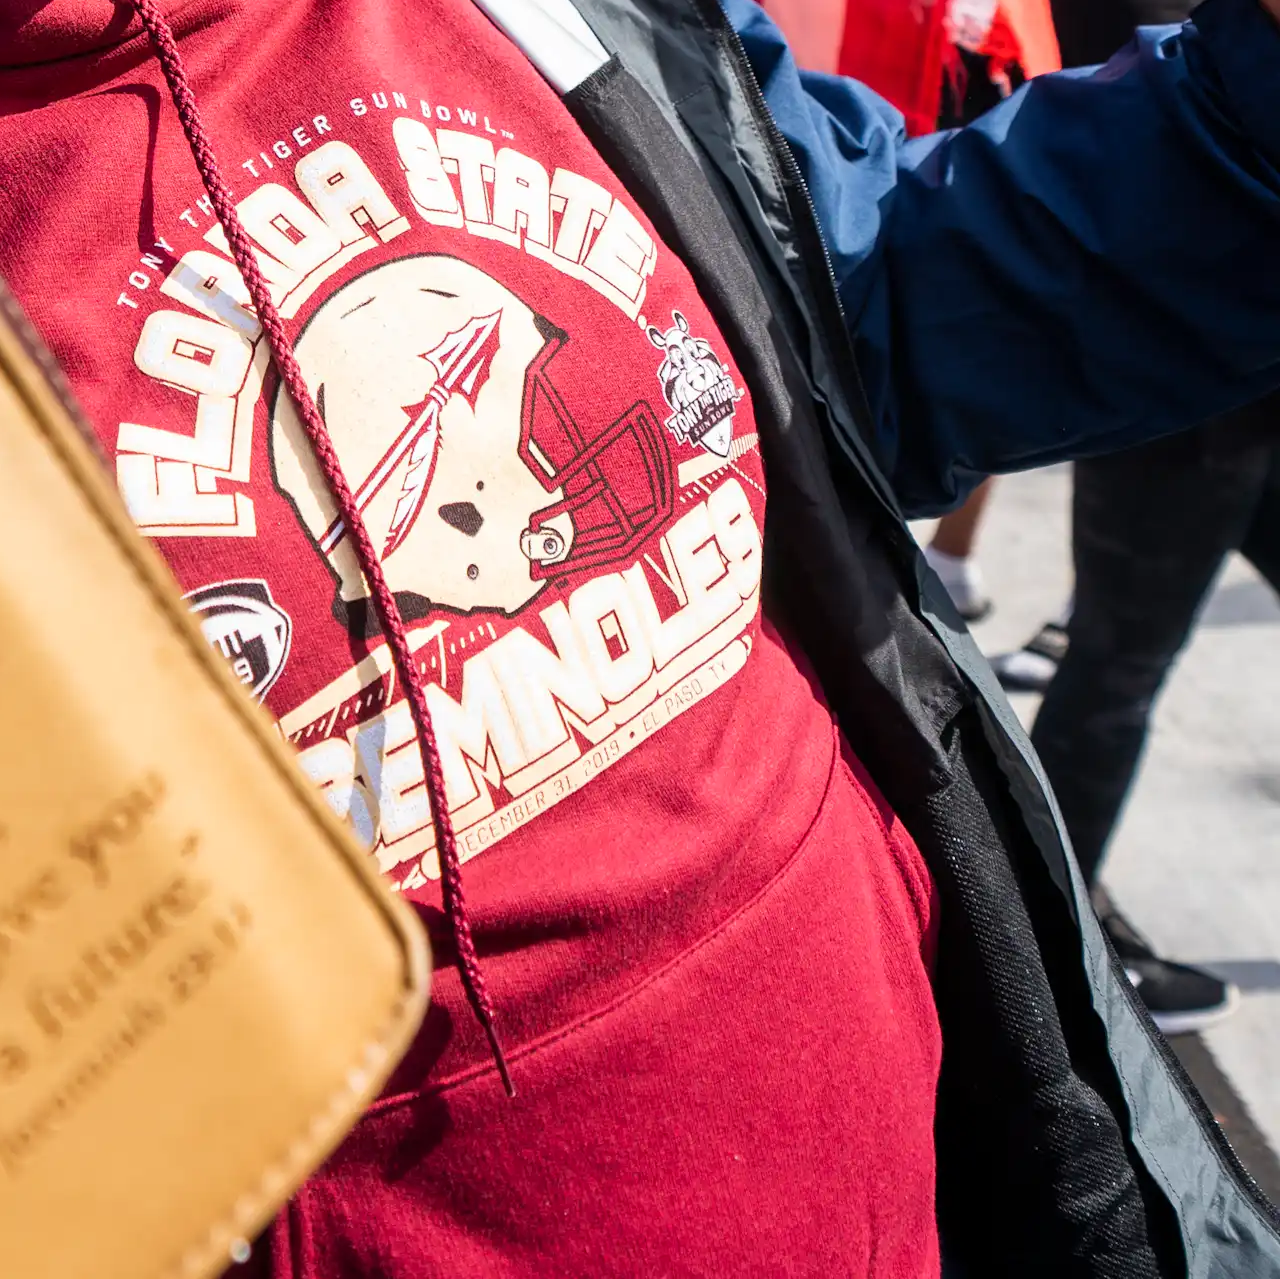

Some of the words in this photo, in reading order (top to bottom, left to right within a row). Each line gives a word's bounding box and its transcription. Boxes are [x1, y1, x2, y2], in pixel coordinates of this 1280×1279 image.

[117, 237, 174, 309] TONY
[179, 183, 234, 228] TH
[242, 114, 333, 178] TIGER
[349, 91, 408, 116] SUN
[393, 116, 658, 322] STATE
[582, 739, 620, 777] 2019
[642, 711, 660, 732] EL
[664, 678, 703, 715] PASO
[68, 773, 166, 890] you
